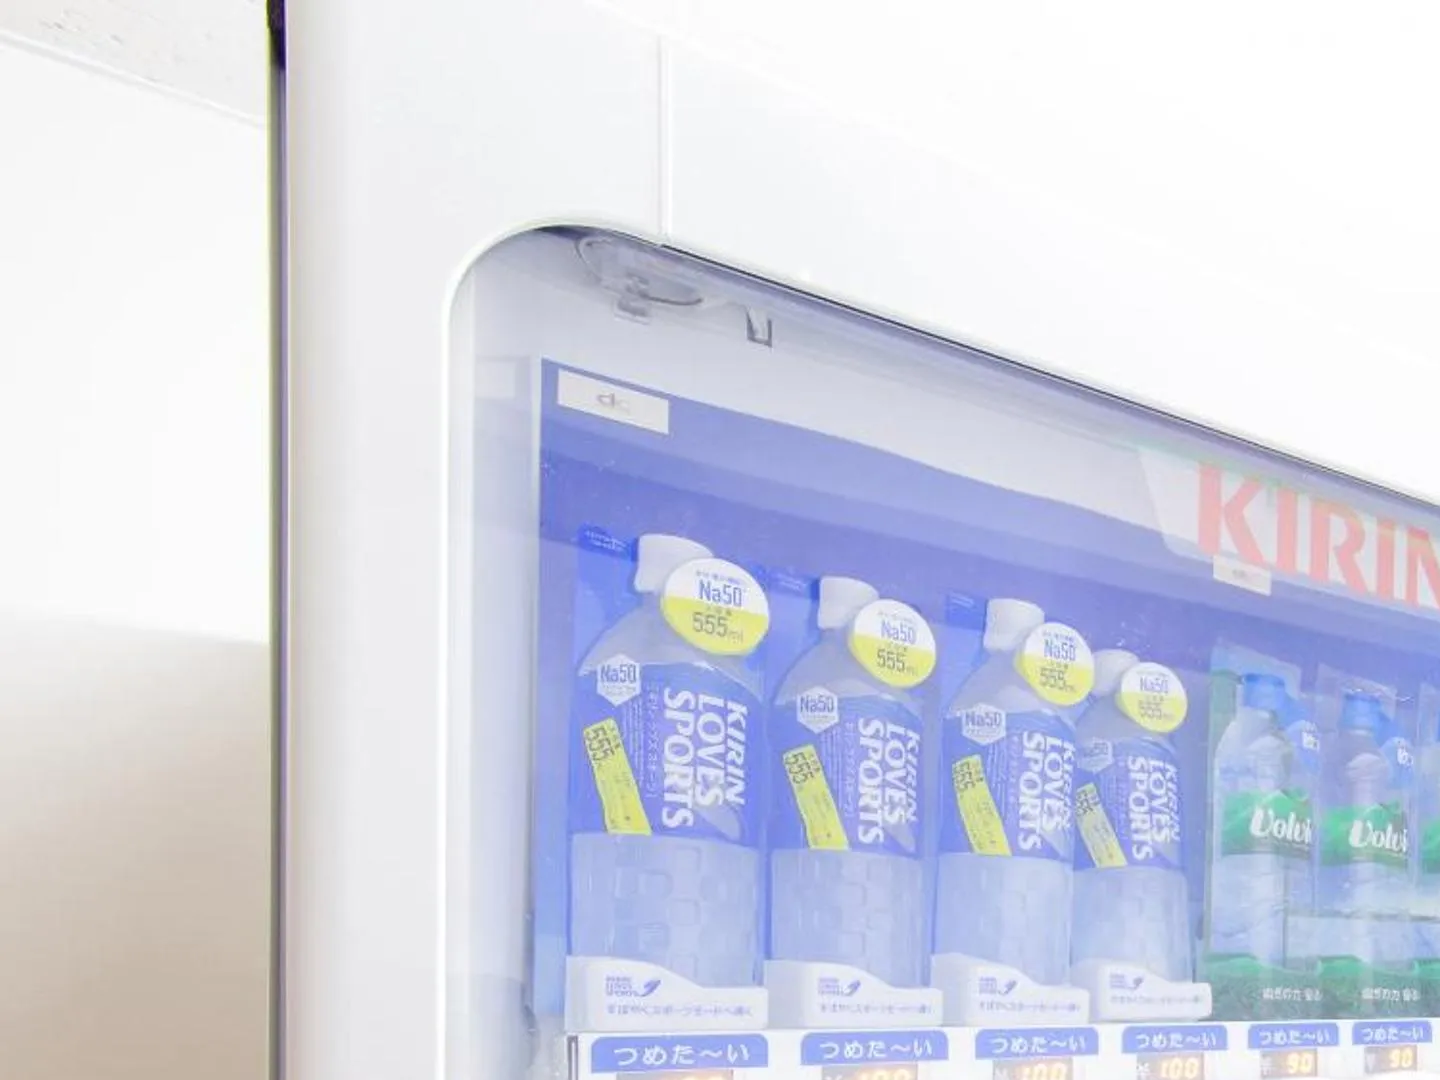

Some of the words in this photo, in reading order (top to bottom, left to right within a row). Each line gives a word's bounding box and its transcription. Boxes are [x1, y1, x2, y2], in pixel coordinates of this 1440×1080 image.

[699, 579, 743, 607] Na50
[692, 612, 743, 643] 555ml
[880, 620, 916, 645] Na50
[1044, 638, 1076, 661] Na50
[600, 664, 636, 684] Na50
[800, 695, 834, 713] Na50
[965, 711, 1001, 728] Na50
[662, 688, 694, 828] SPORTS
[694, 694, 727, 806] LOVES
[726, 700, 748, 805] KIRIN
[884, 723, 906, 825] LOVES
[904, 728, 920, 822] KIRIN
[858, 717, 885, 845] SPORTS
[1018, 731, 1045, 850] SPORTS
[1043, 736, 1064, 832] LOVES
[1127, 756, 1153, 860] SPORTS
[1149, 758, 1171, 843] LOVES
[1160, 1058, 1199, 1080] 100
[1287, 1053, 1312, 1073] 90
[1390, 1049, 1414, 1068] 90
